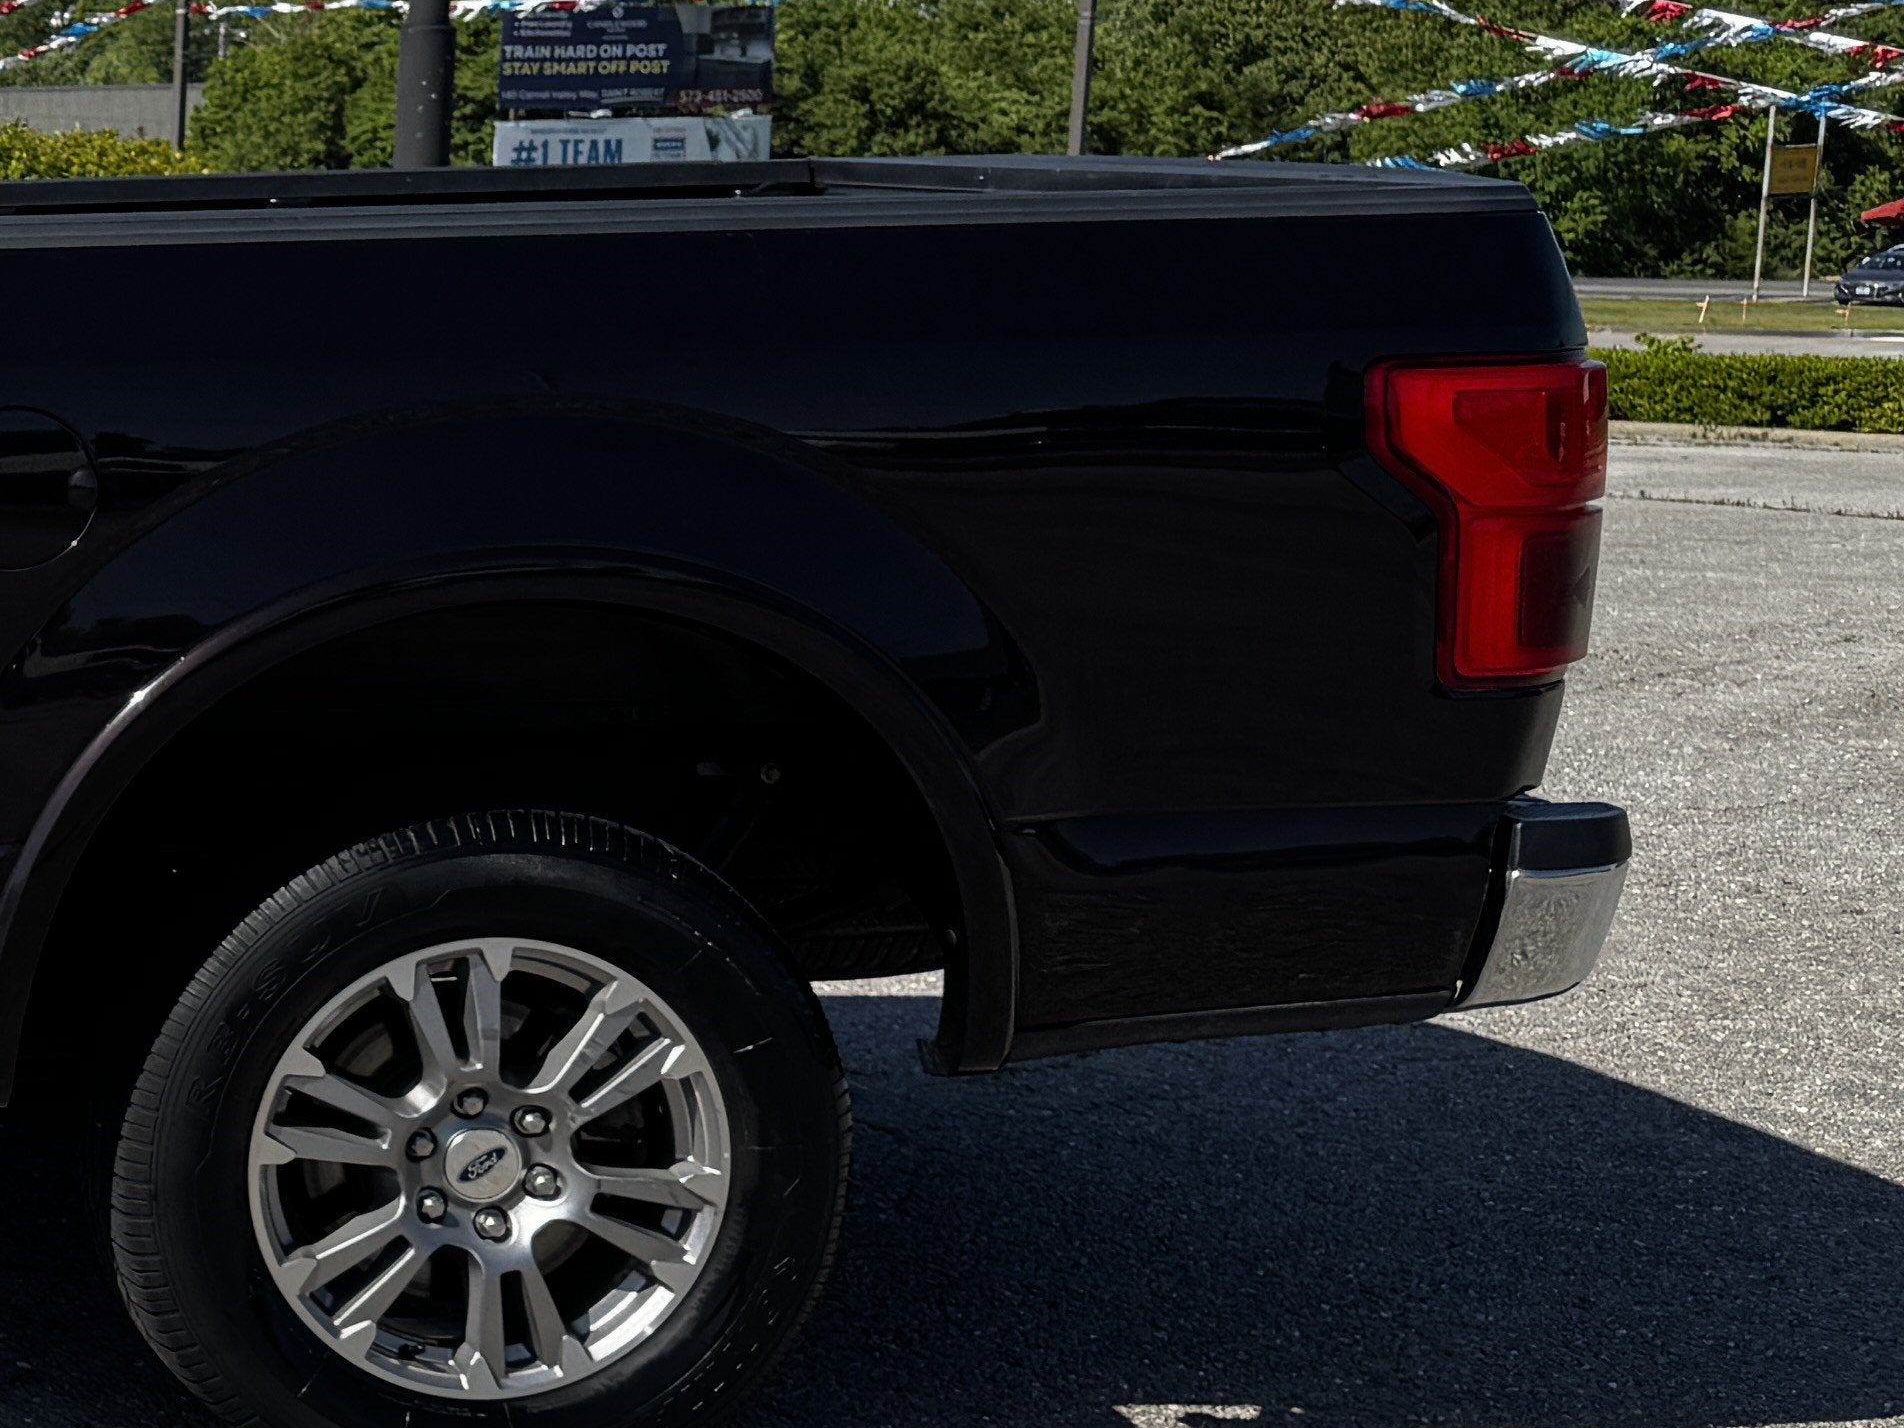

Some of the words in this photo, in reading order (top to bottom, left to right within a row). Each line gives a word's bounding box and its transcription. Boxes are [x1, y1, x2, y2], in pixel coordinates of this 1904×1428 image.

[504, 45, 552, 59] TRAIN
[553, 45, 597, 59] HARD
[599, 45, 623, 58] ON
[626, 43, 668, 58] POST
[502, 61, 541, 76] STAY
[542, 61, 596, 76] SMART
[597, 60, 628, 73] OFF
[629, 59, 671, 74] POST
[510, 139, 550, 165] #1
[558, 138, 623, 165] TEAM
